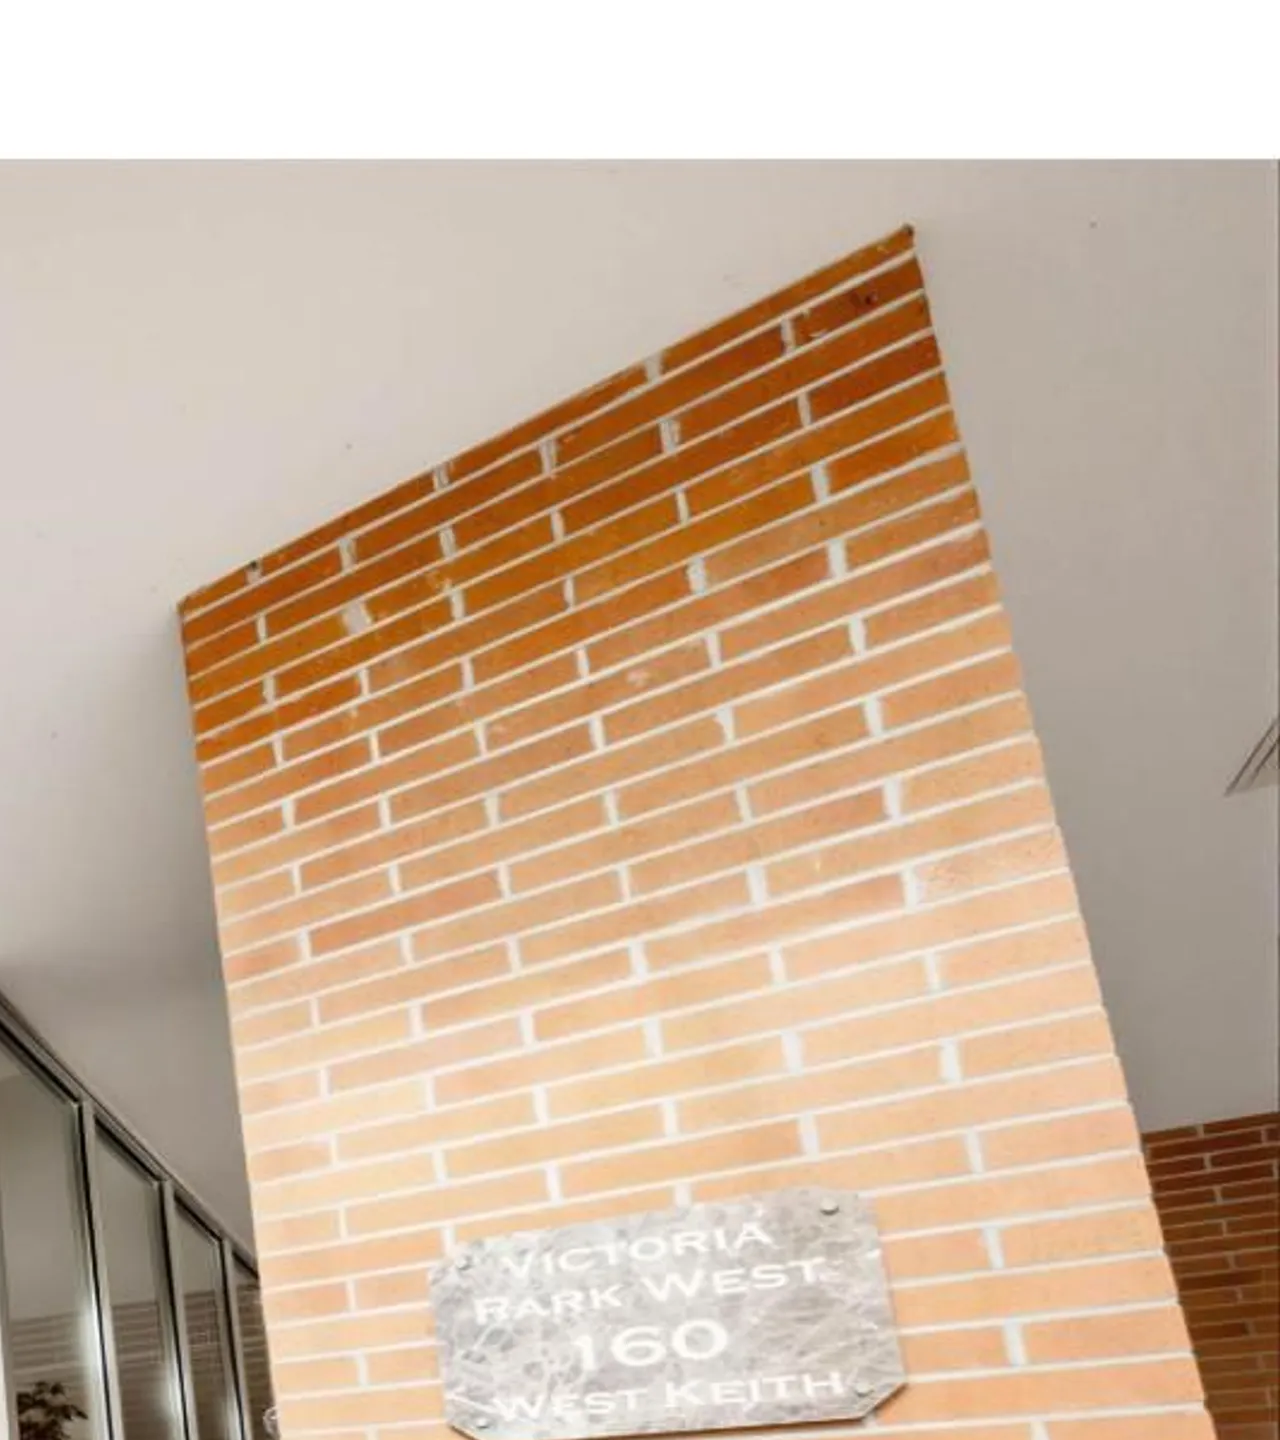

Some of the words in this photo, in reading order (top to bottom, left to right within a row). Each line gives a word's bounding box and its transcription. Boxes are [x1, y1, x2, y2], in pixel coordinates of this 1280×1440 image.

[502, 1222, 773, 1279] VICTORIA
[473, 1284, 625, 1325] PARK
[642, 1256, 827, 1302] WEST
[574, 1319, 728, 1372] 160
[492, 1389, 644, 1422] WEST
[665, 1372, 842, 1409] KEITH
